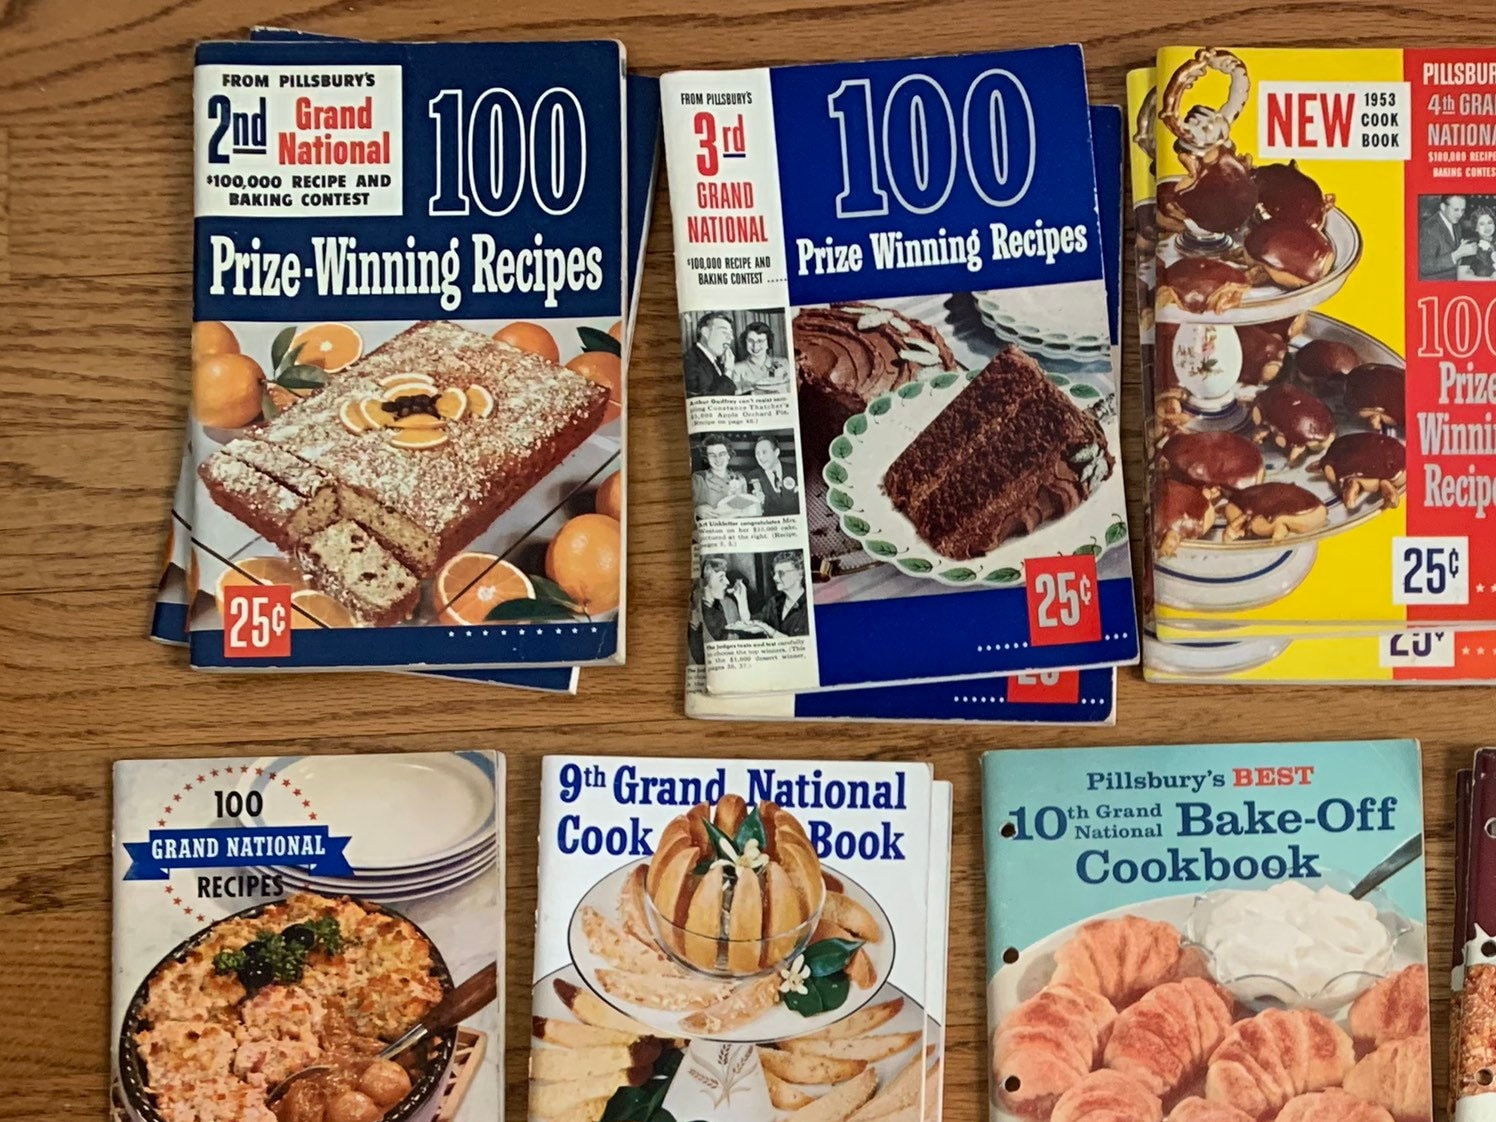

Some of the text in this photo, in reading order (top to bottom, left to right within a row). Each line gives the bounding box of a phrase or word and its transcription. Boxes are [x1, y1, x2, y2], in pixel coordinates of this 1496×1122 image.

[1364, 93, 1396, 106] 1953
[207, 95, 372, 164] 2nd Grand
[1267, 93, 1356, 148] NEW
[1361, 113, 1399, 127] COOK
[279, 132, 390, 165] National
[429, 87, 586, 216] 100
[827, 68, 1036, 218] 100
[1362, 133, 1399, 147] BOOK
[207, 175, 391, 188] $100,000 RECIPE AND
[697, 182, 754, 209] GRAND
[688, 216, 768, 243] NATIONAL
[797, 220, 1088, 276] Prize Winning Recipes
[210, 234, 603, 311] Prize-Winning Recipes
[1404, 548, 1459, 593] 25¢
[1035, 571, 1092, 628] 25¢
[1087, 766, 1315, 794] Pillsbury's BEST
[215, 791, 263, 818] 100
[1176, 797, 1398, 837] Bake-Off
[152, 835, 326, 860] GRAND NATIONAL
[557, 814, 906, 861] Cook Book
[1075, 845, 1322, 885] Cookbook
[197, 875, 283, 899] RECIPES
